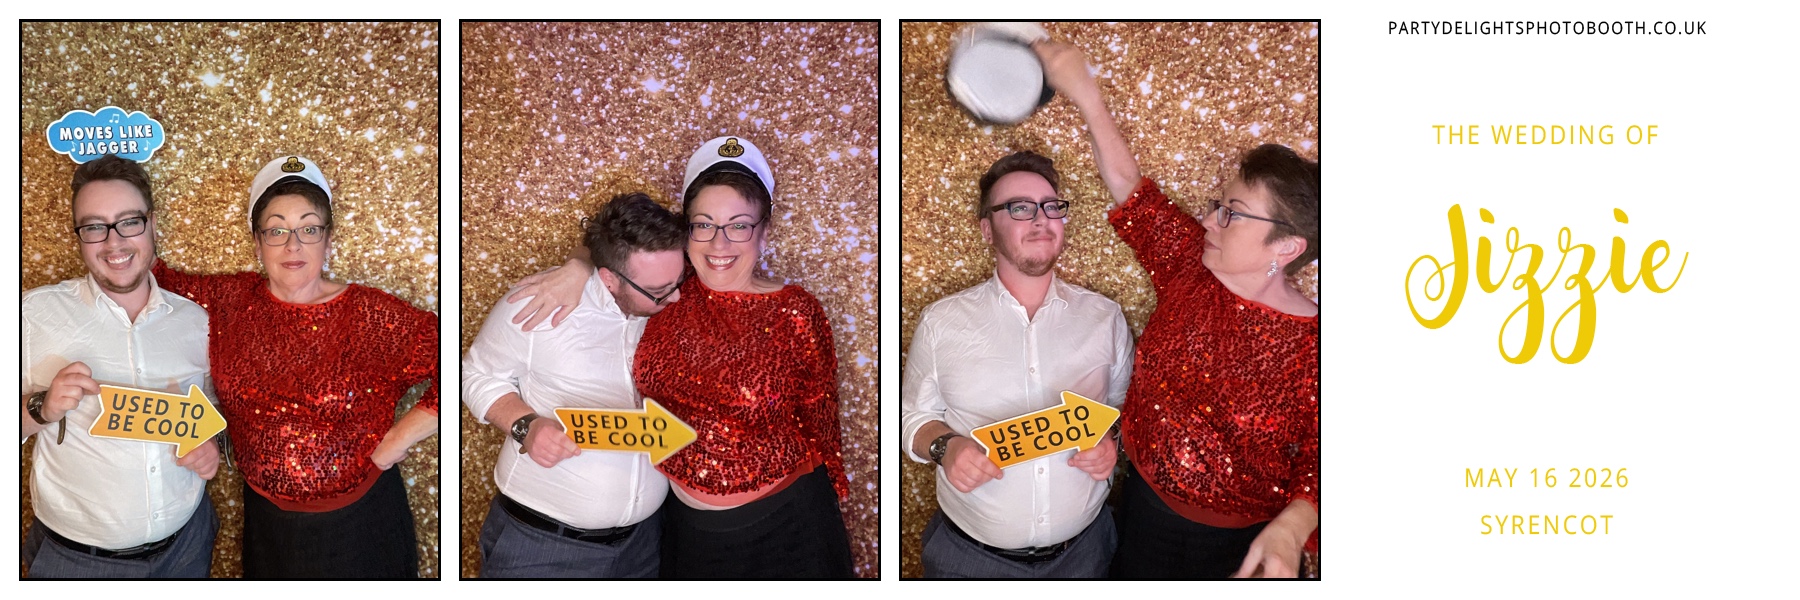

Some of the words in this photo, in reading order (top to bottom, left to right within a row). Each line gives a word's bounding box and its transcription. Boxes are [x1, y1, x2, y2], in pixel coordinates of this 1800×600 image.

[60, 126, 113, 141] MOVES
[119, 124, 153, 139] LIKE
[78, 140, 139, 156] JAGGER
[112, 393, 169, 416] USED
[180, 402, 205, 420] TO
[107, 413, 134, 432] BE
[143, 417, 199, 439] COOL
[570, 413, 628, 430] USED
[638, 416, 668, 431] TO
[989, 416, 1050, 445] USED
[1058, 405, 1090, 425] TO
[573, 430, 598, 445] BE
[608, 431, 668, 449] COOL
[996, 441, 1025, 462] BE
[1033, 423, 1095, 451] COOL
